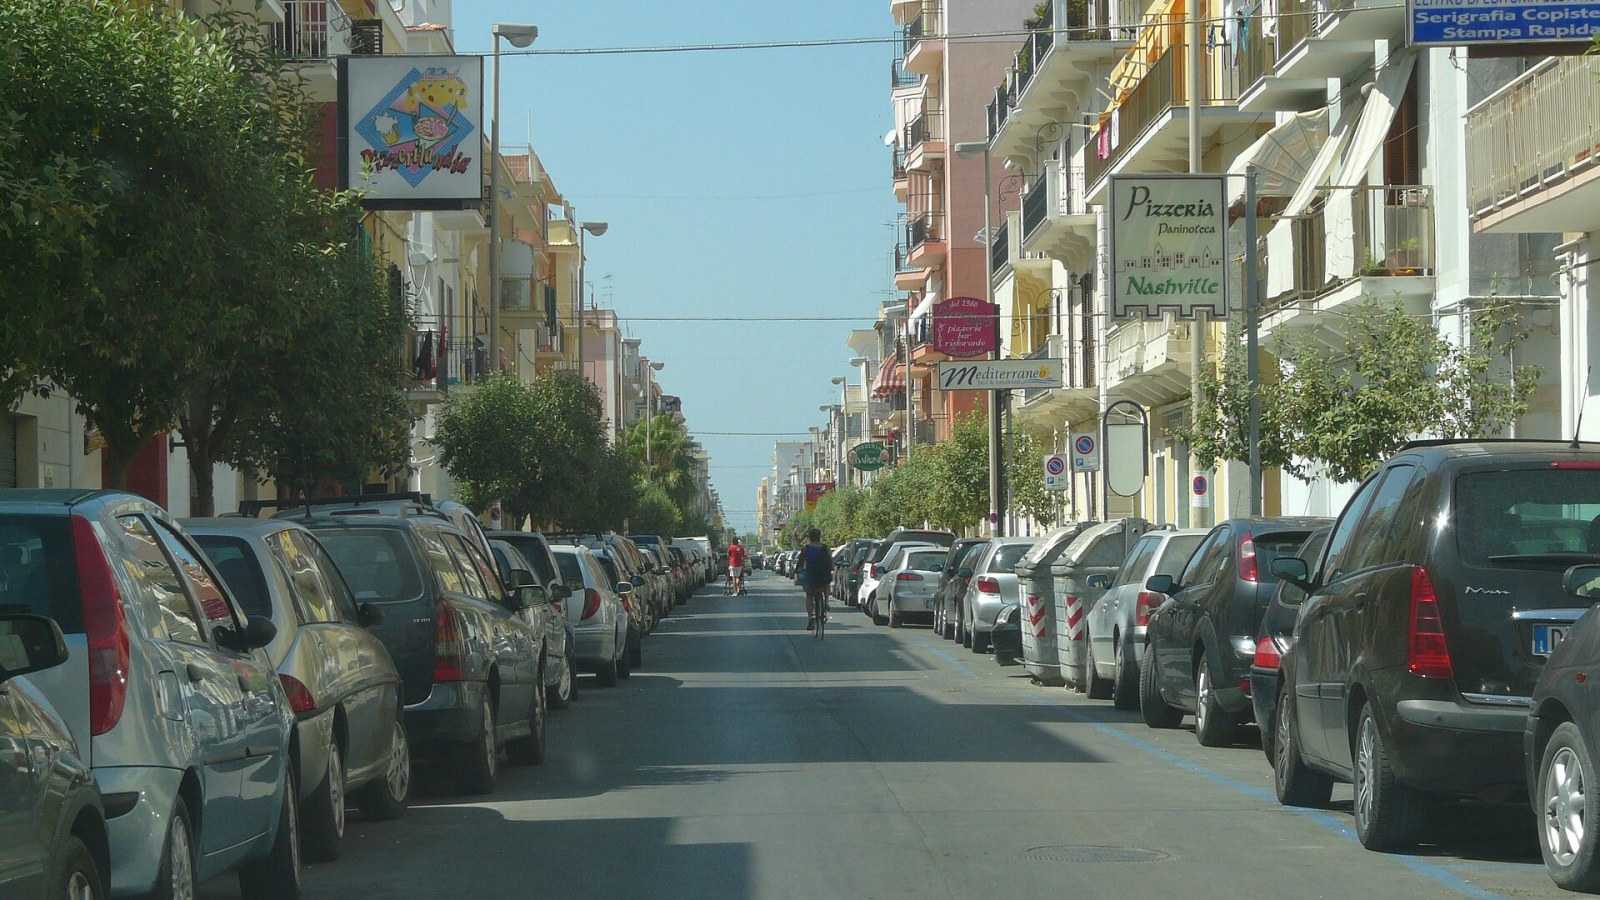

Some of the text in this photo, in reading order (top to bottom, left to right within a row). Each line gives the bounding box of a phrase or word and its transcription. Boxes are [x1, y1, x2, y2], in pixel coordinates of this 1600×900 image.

[1416, 10, 1516, 25] Serigrafia
[1443, 24, 1600, 39] Stampa Rapida
[1122, 186, 1215, 221] Pizzeria
[1158, 223, 1216, 236] Paninoteca
[1126, 276, 1219, 295] Nashville
[947, 325, 982, 334] pizzeria
[957, 330, 972, 339] bar
[945, 338, 986, 347] ristorante
[1465, 586, 1510, 594] Musa
